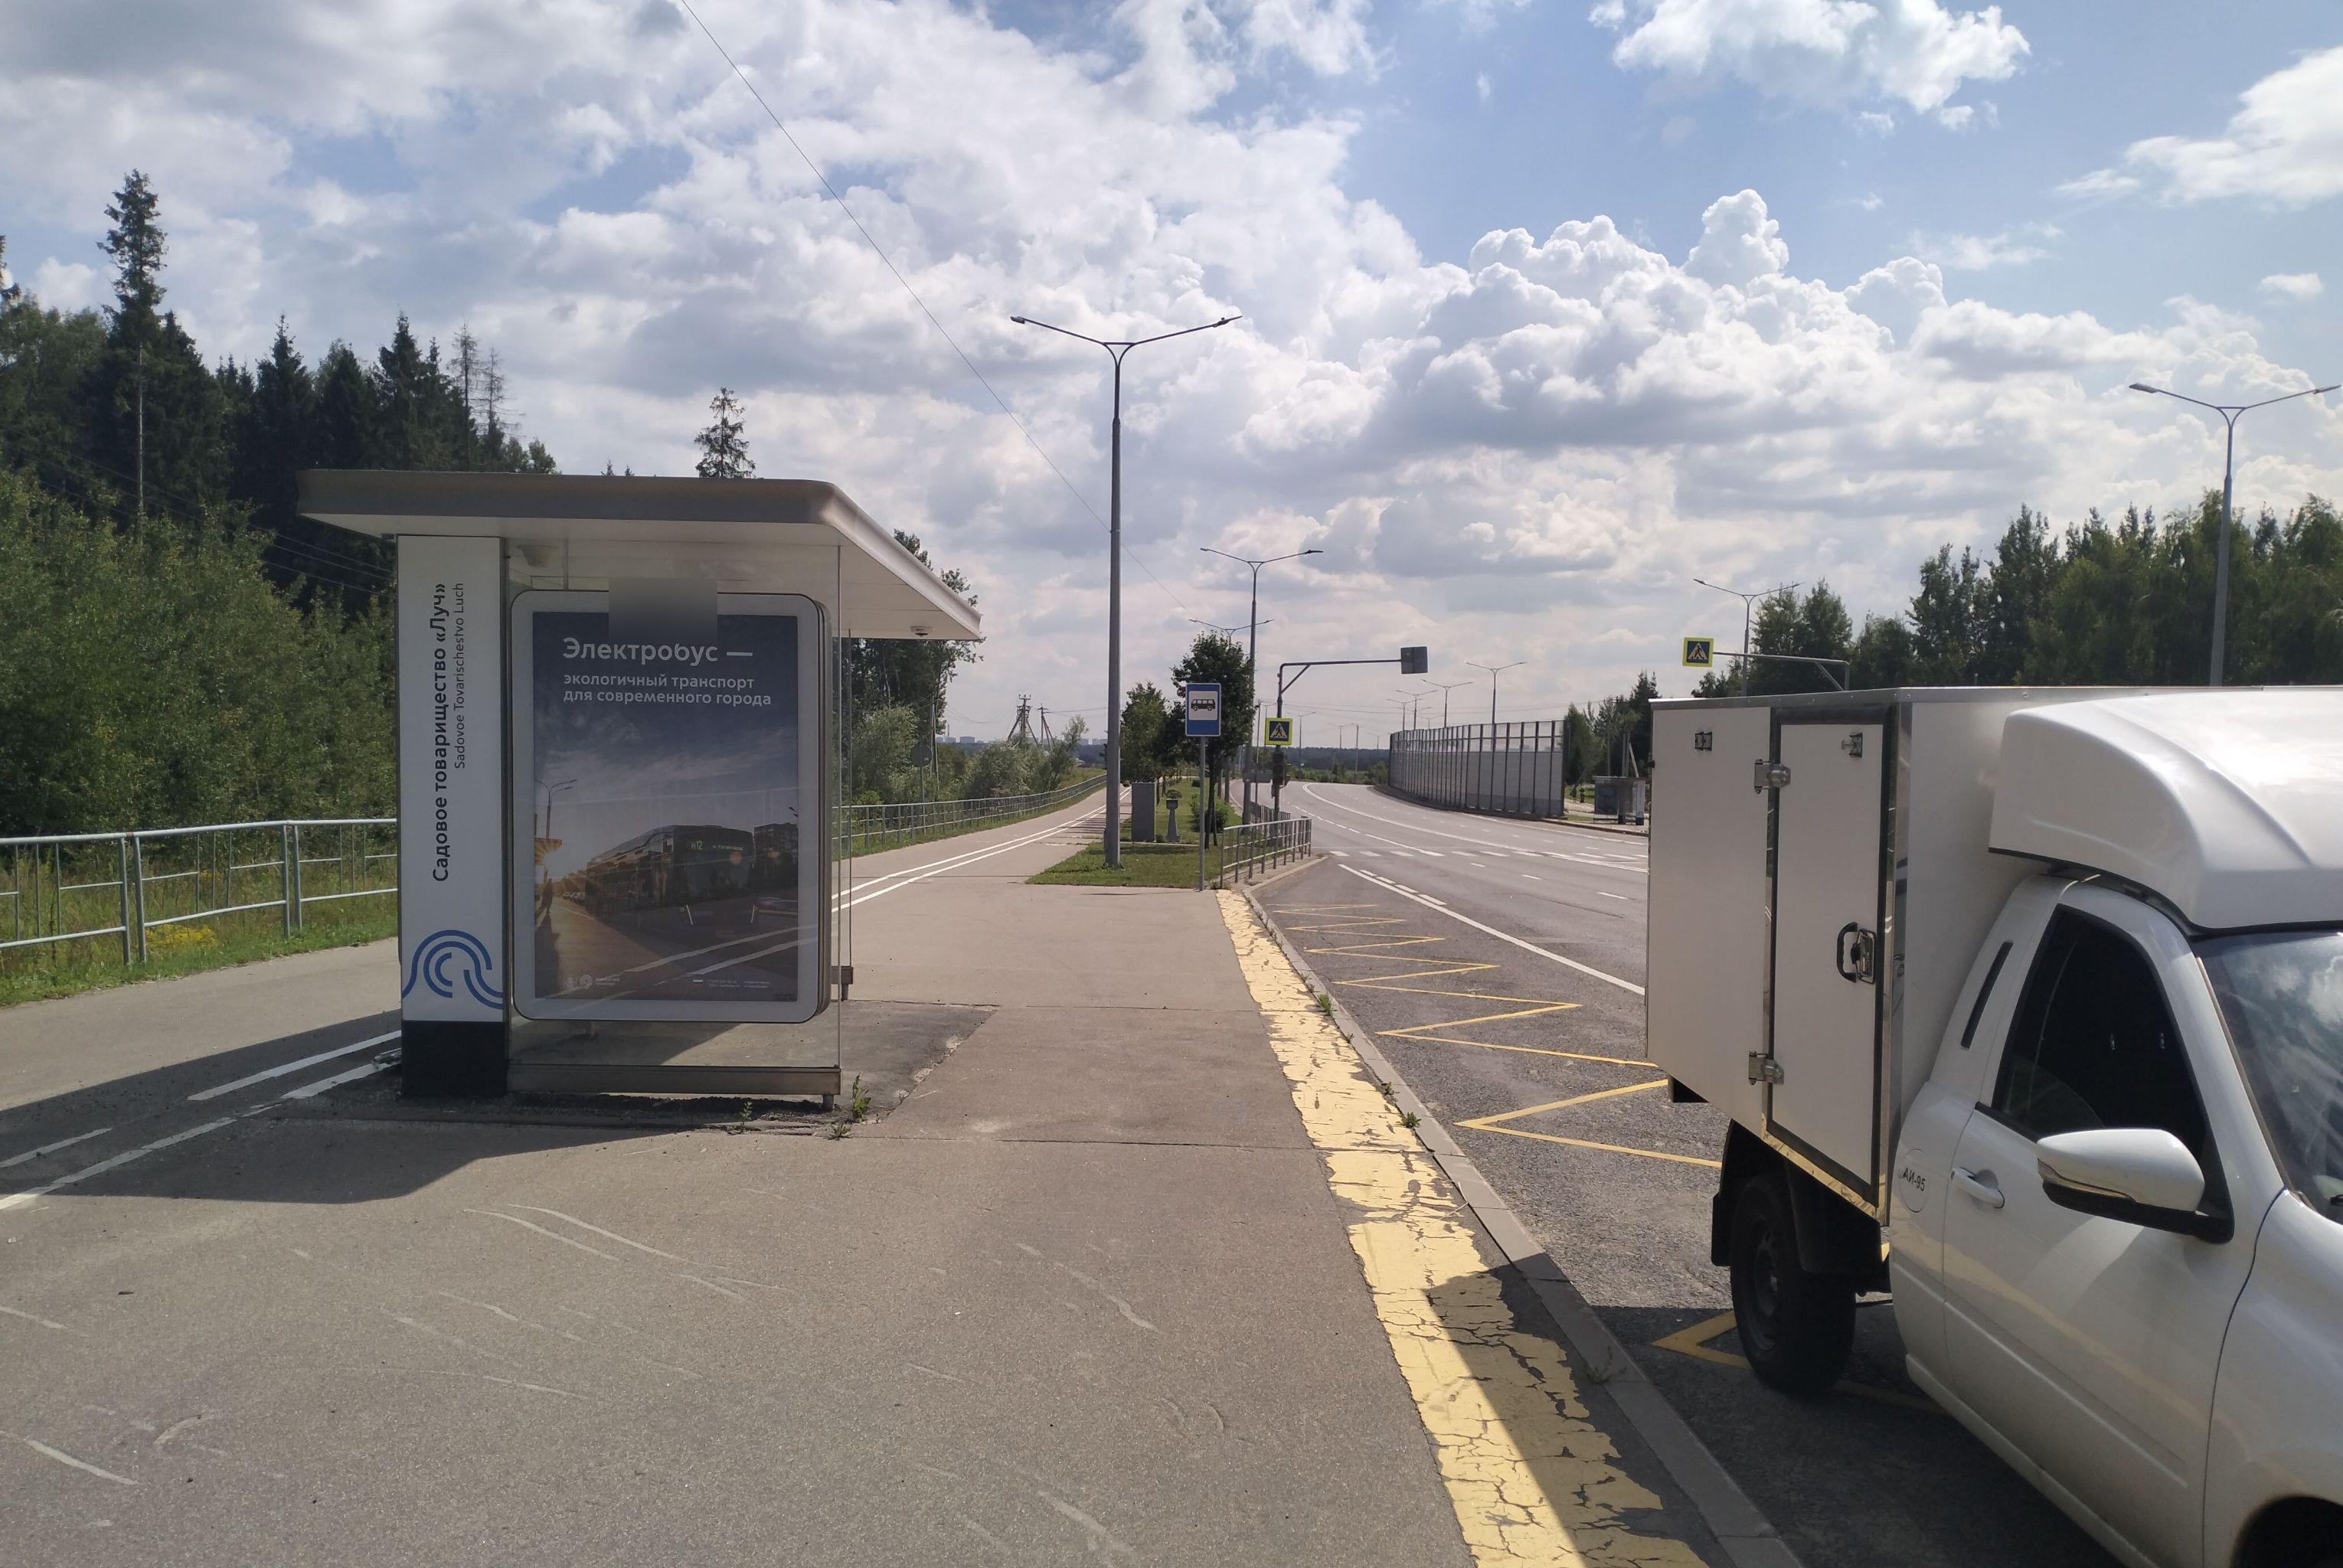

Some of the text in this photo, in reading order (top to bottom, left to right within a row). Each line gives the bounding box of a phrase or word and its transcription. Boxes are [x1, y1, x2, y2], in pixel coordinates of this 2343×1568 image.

[563, 637, 718, 666] Электробус
[452, 583, 465, 769] Sadovoe Tovarischestvo Luch
[564, 674, 754, 691] экологичный транспорт
[564, 691, 771, 707] для современного города
[430, 583, 450, 881] Садовое товарищество «Луч»
[1903, 1167, 1926, 1192] АИ-95
